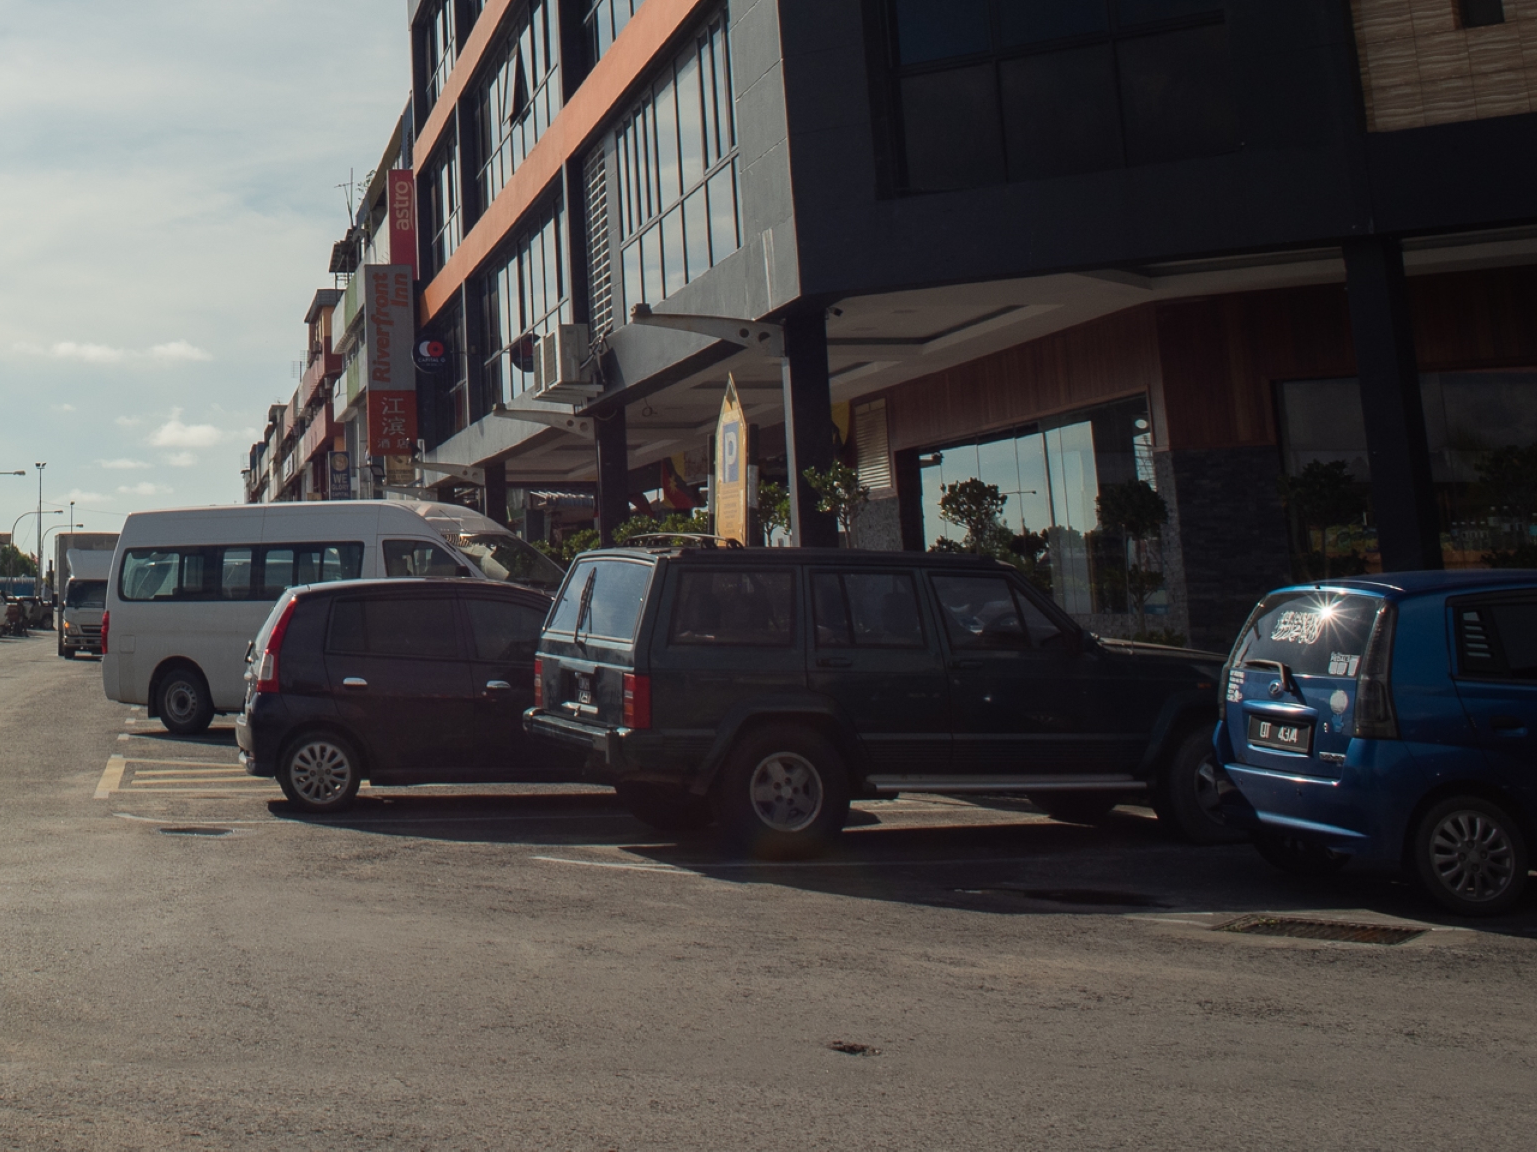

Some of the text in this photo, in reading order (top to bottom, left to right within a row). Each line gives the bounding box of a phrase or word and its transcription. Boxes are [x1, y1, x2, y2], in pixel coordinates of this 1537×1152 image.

[393, 180, 410, 231] astro
[390, 272, 409, 308] Inn
[370, 271, 395, 383] Riverfront
[381, 396, 406, 436] 江滨
[724, 431, 738, 483] P
[332, 473, 348, 484] WE
[1259, 721, 1272, 739] QT
